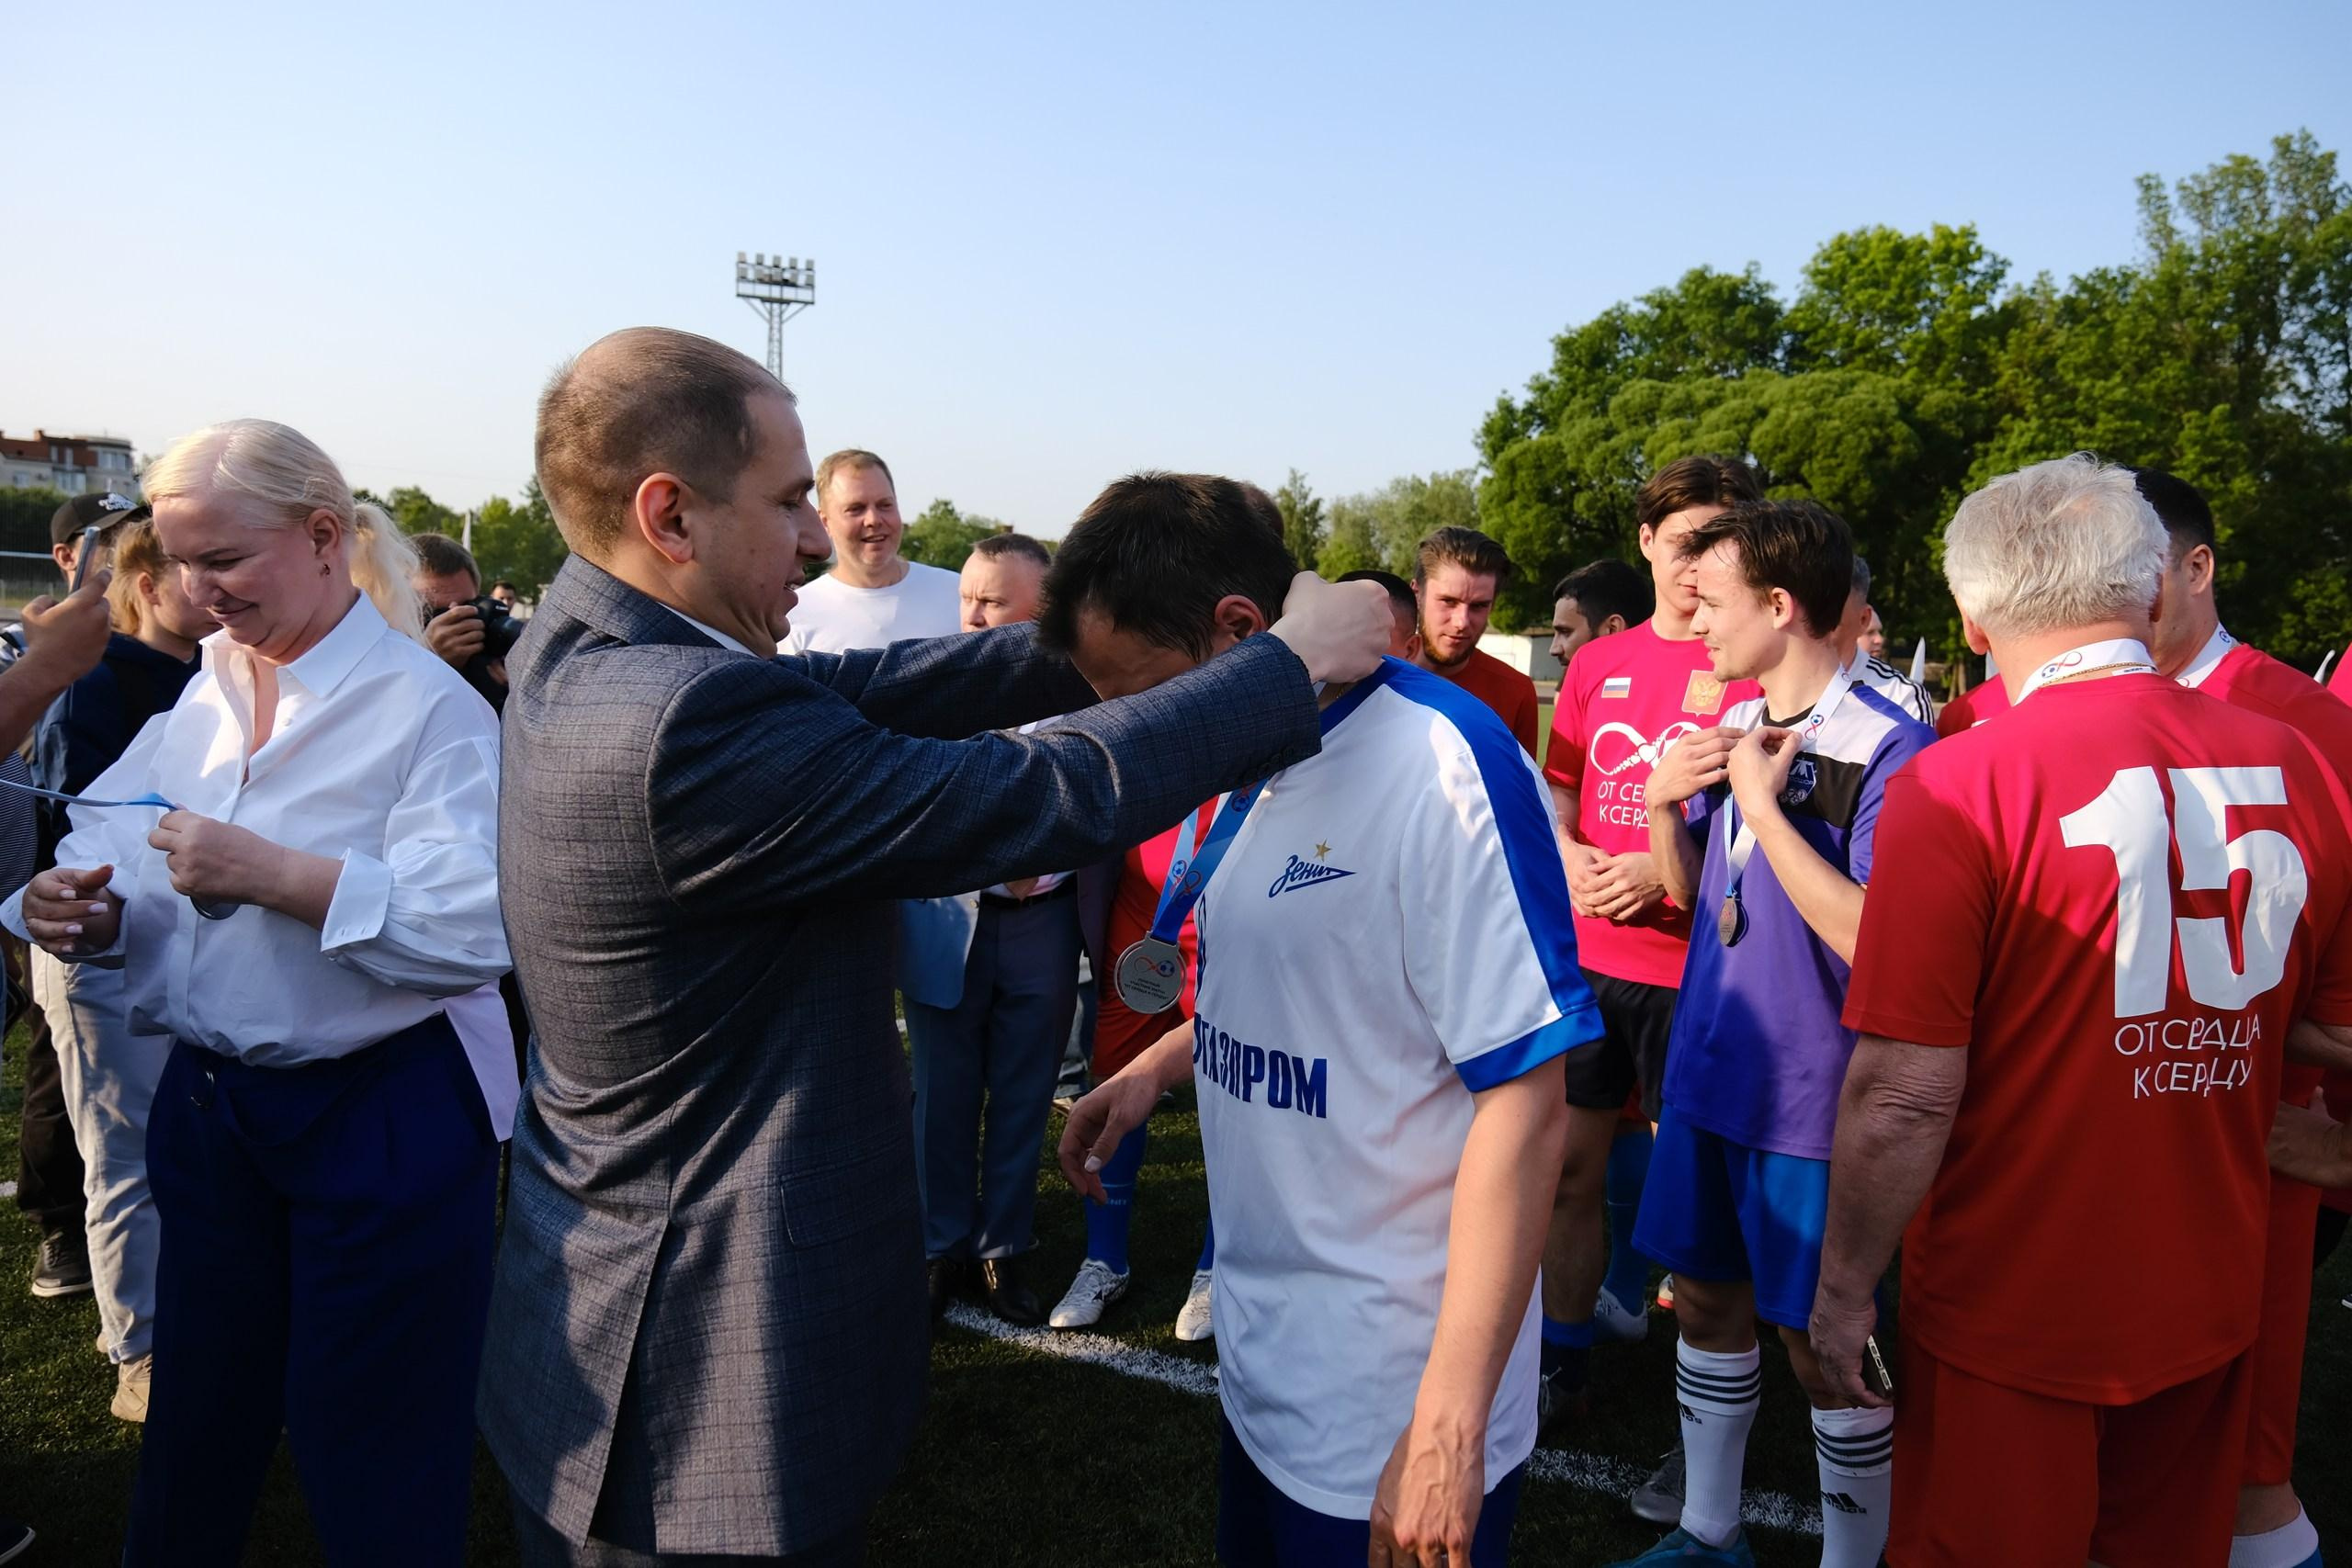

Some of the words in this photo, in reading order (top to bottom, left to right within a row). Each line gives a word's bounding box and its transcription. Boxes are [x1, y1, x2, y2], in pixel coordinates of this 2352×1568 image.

[1598, 781, 1616, 800] ОТ
[1620, 783, 1646, 806] СЕ
[1600, 804, 1608, 822] К
[1610, 805, 1650, 829] СЕРД
[2059, 766, 2307, 1018] 15
[2154, 1055, 2253, 1098] СЕРЦУ
